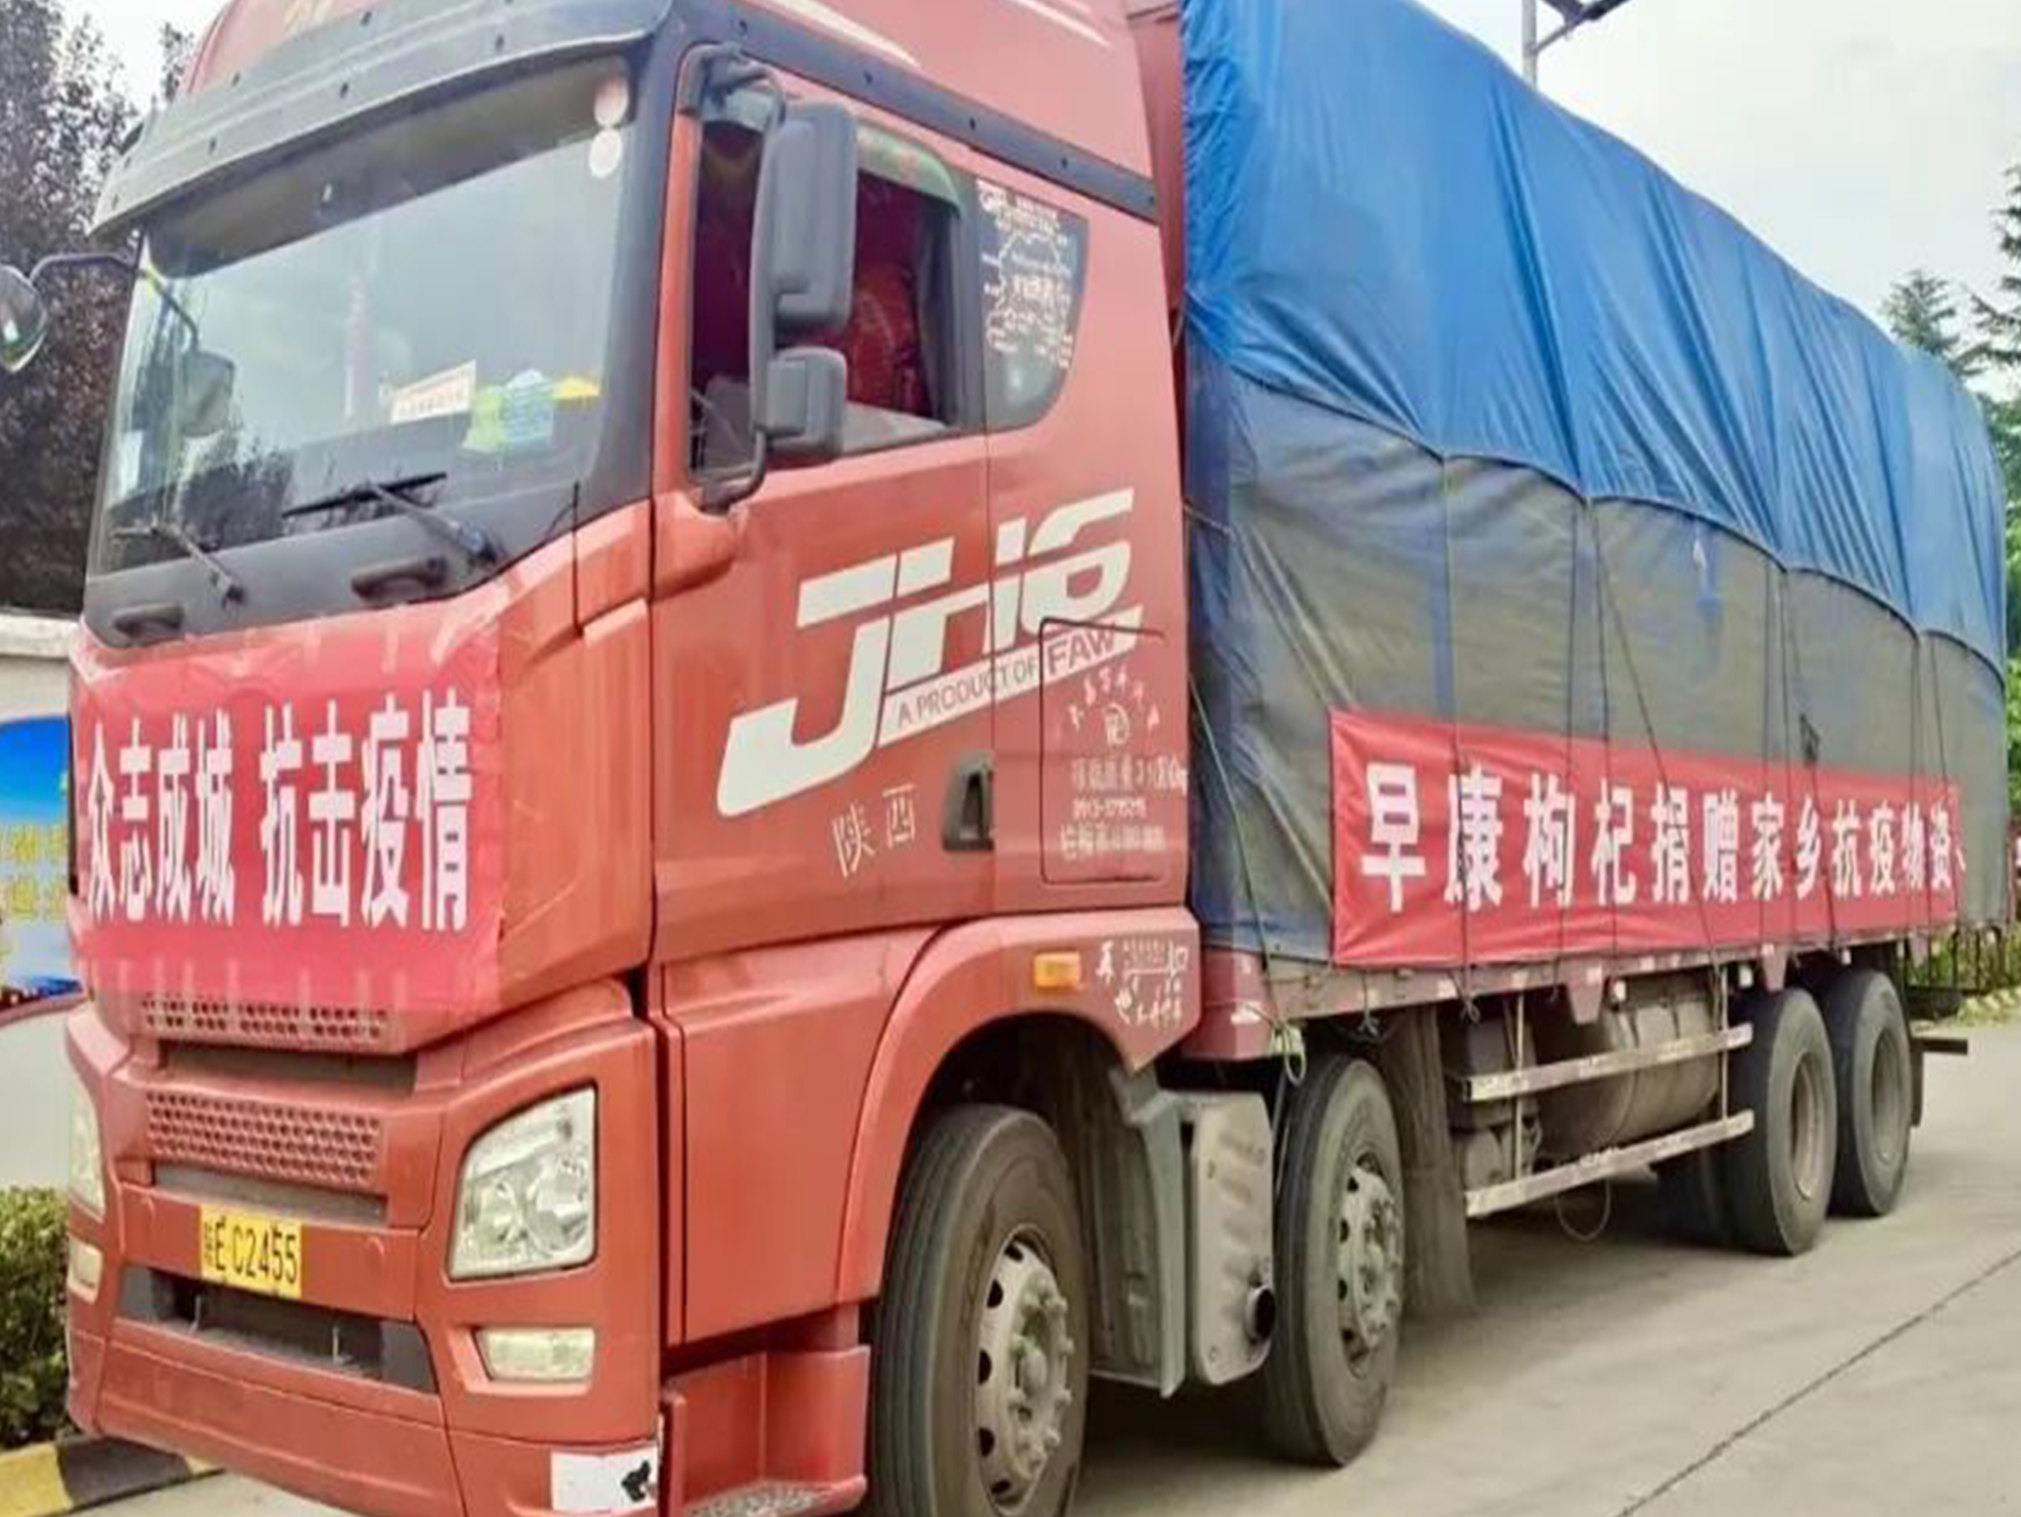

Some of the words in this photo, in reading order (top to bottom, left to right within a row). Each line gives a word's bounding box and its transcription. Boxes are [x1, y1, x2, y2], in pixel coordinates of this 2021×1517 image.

[898, 702, 912, 728] A
[917, 666, 1012, 720] PRODUCT
[1013, 657, 1039, 685] OF
[1049, 624, 1115, 676] FAW
[88, 707, 235, 926] 众志成城
[260, 688, 472, 932] 抗击疫情
[831, 782, 915, 878] 陕西
